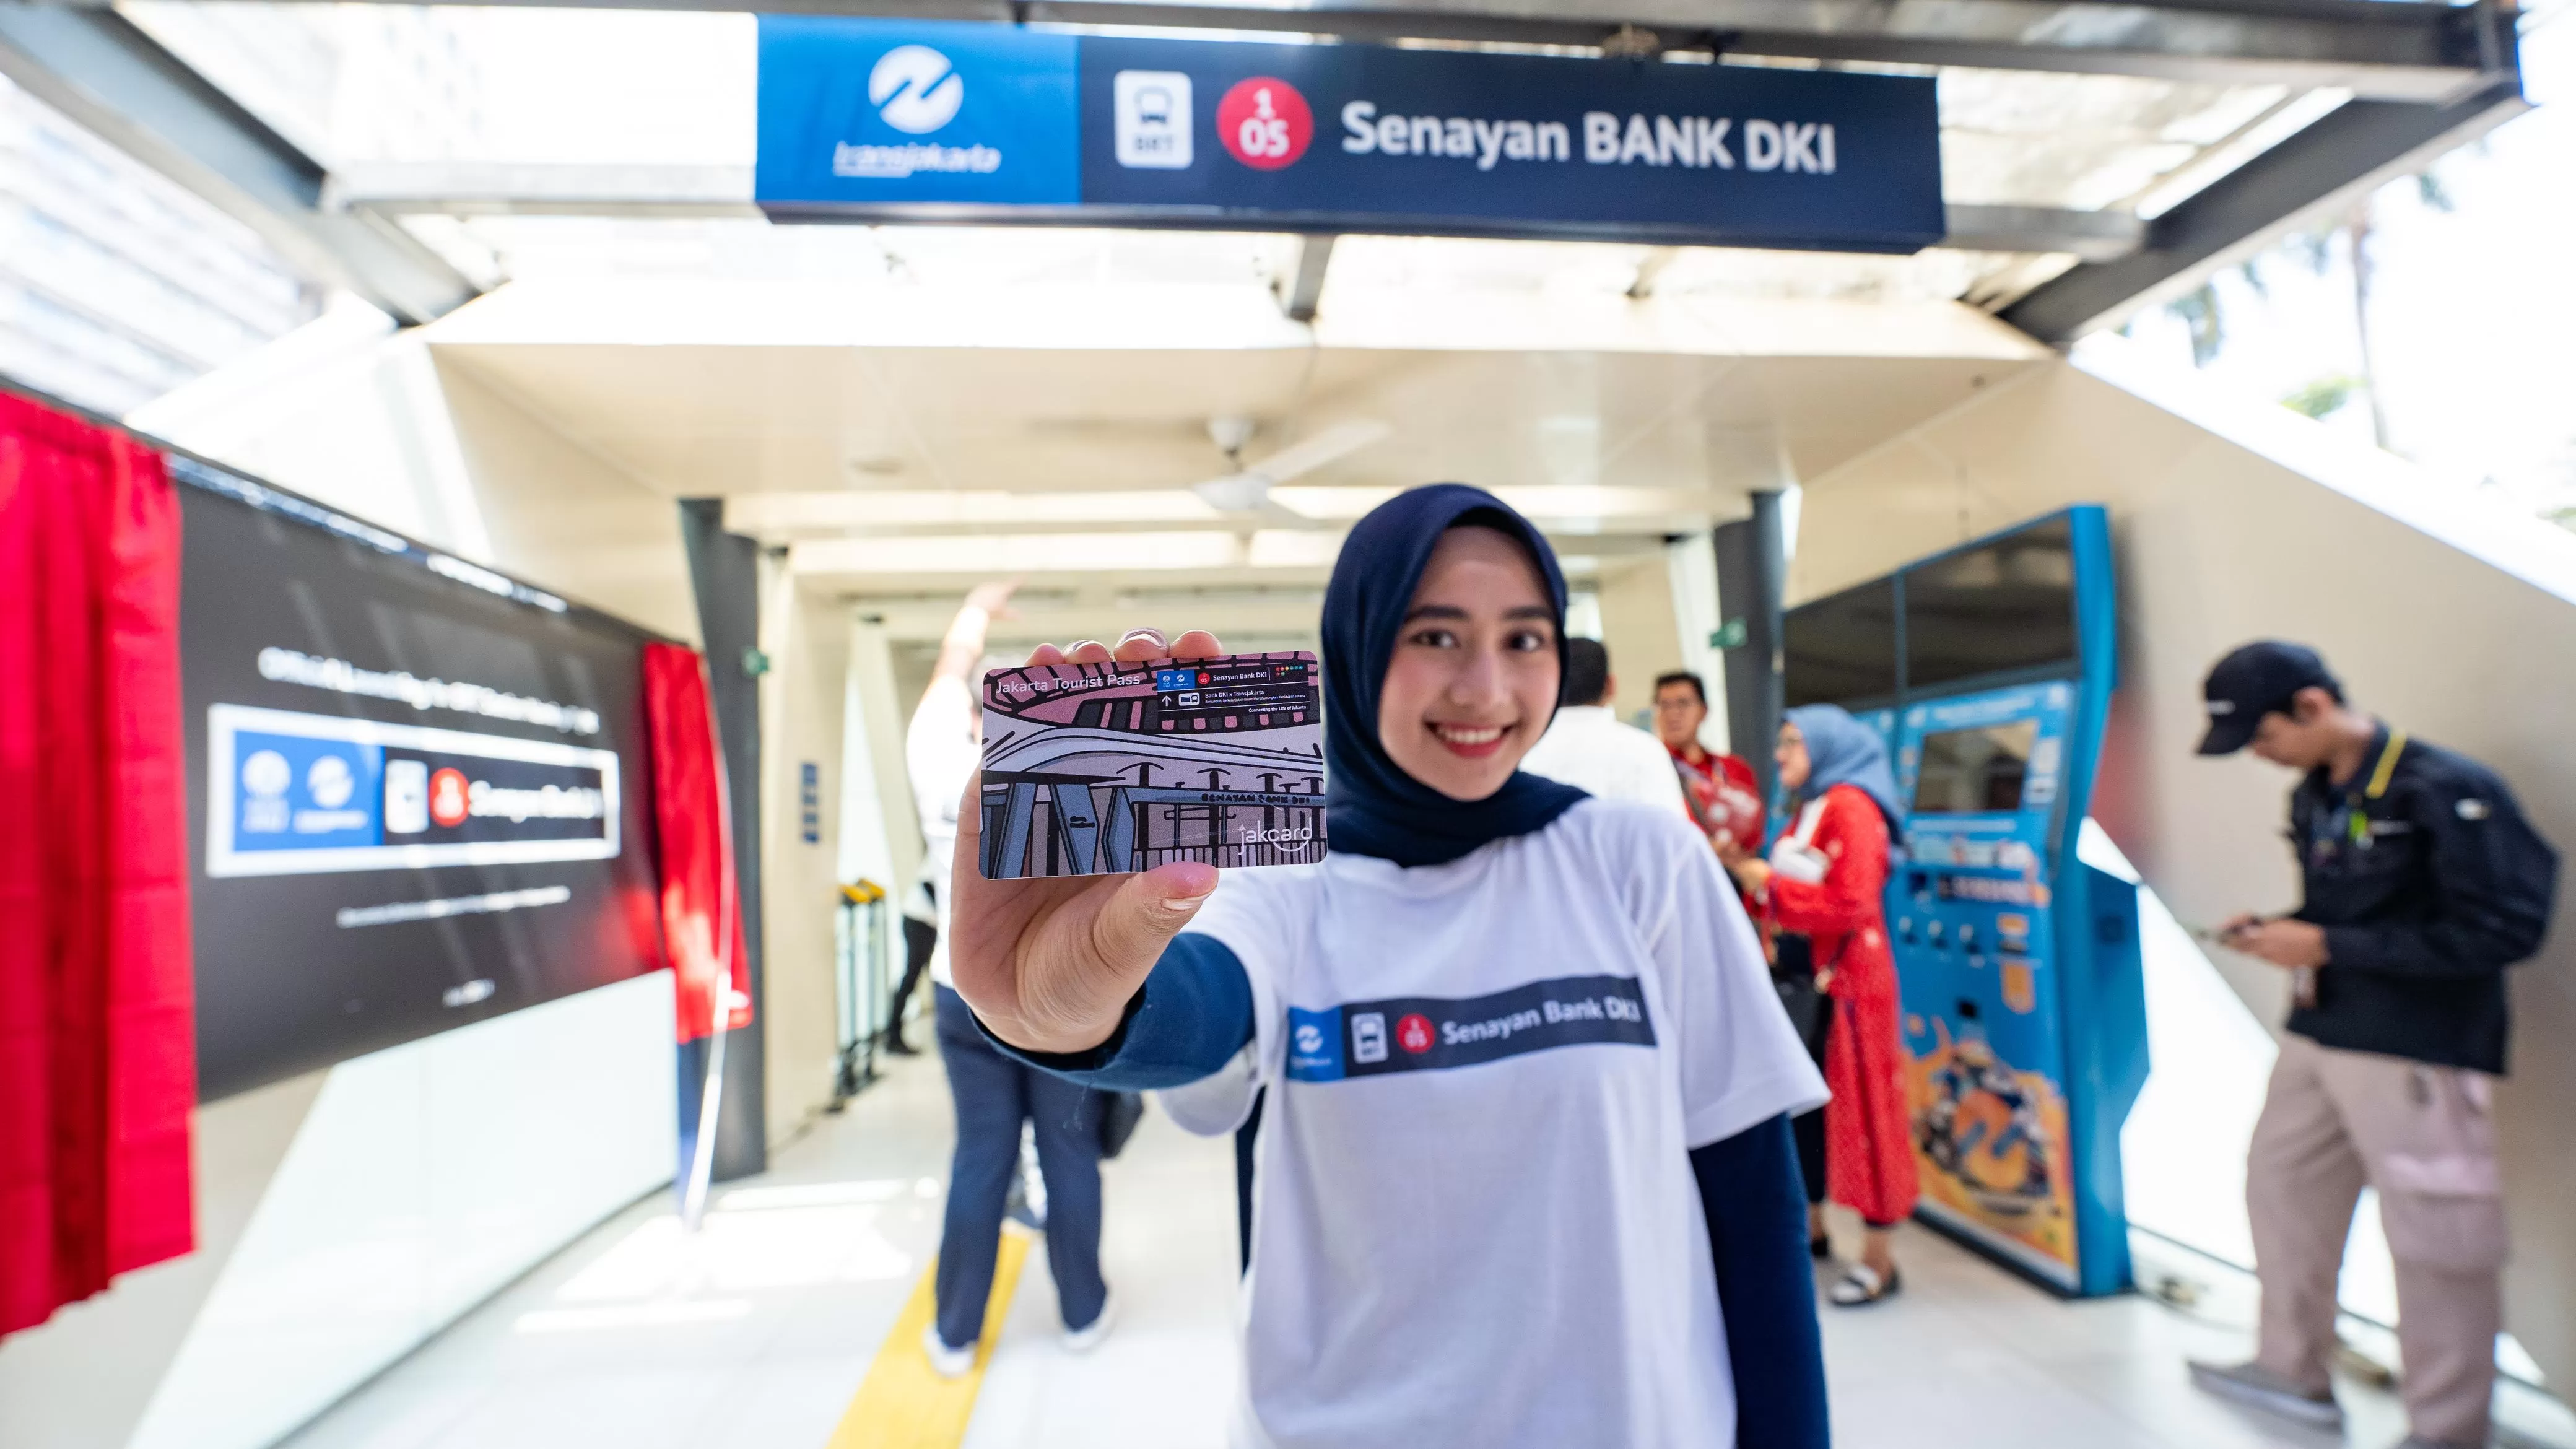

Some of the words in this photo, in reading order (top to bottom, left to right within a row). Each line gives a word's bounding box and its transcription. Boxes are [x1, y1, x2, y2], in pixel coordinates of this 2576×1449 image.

[1254, 87, 1276, 119] 1
[1239, 117, 1290, 157] 05
[1341, 100, 1570, 171] Senayan
[1583, 111, 1735, 169] BANK
[1744, 119, 1837, 175] DKI
[996, 681, 1048, 694] Jakarta
[1053, 676, 1103, 689] Tourist
[1107, 674, 1141, 686] Pass
[1238, 817, 1312, 855] jakcard
[1442, 1009, 1541, 1045] Senayan
[1542, 997, 1604, 1024] Bank
